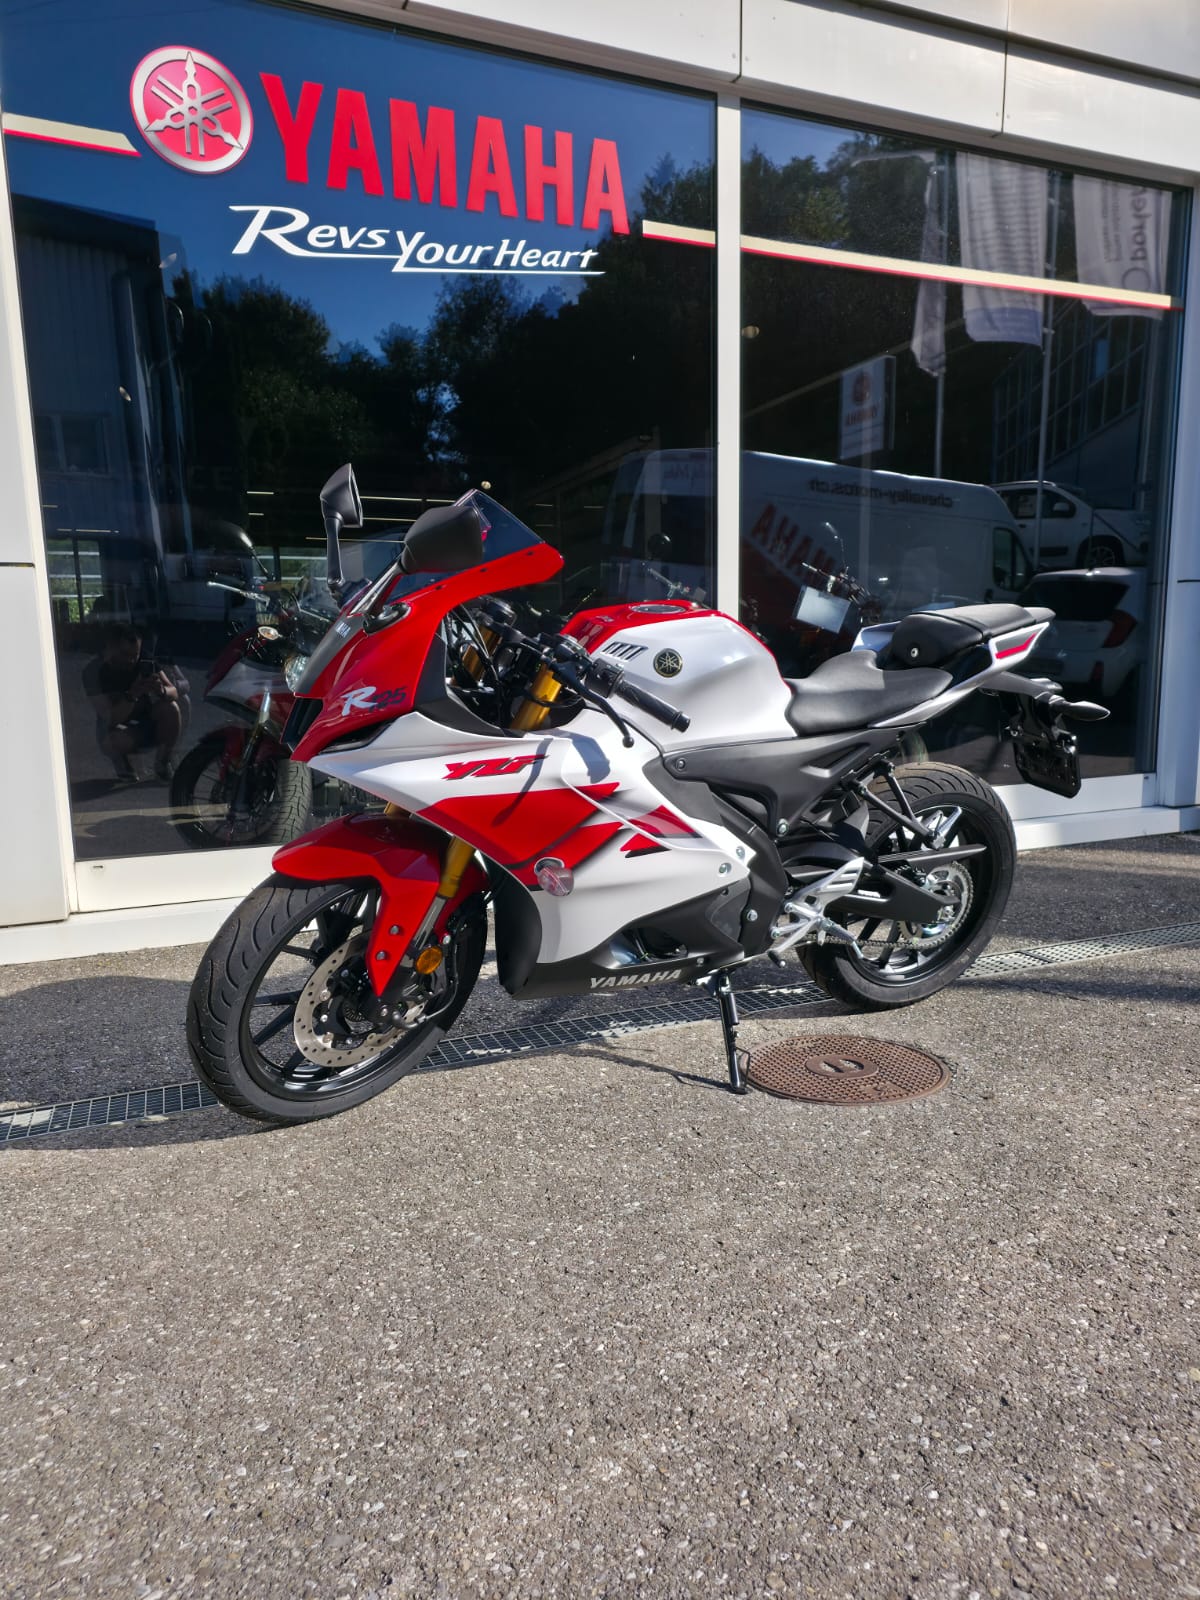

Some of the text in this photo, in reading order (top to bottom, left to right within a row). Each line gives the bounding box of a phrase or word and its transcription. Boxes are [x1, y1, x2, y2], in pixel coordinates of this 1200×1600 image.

[259, 72, 630, 235] YAMAHA
[228, 205, 600, 272] Revs Your Heart
[441, 754, 549, 781] YZF
[590, 969, 682, 989] YAMAHA
